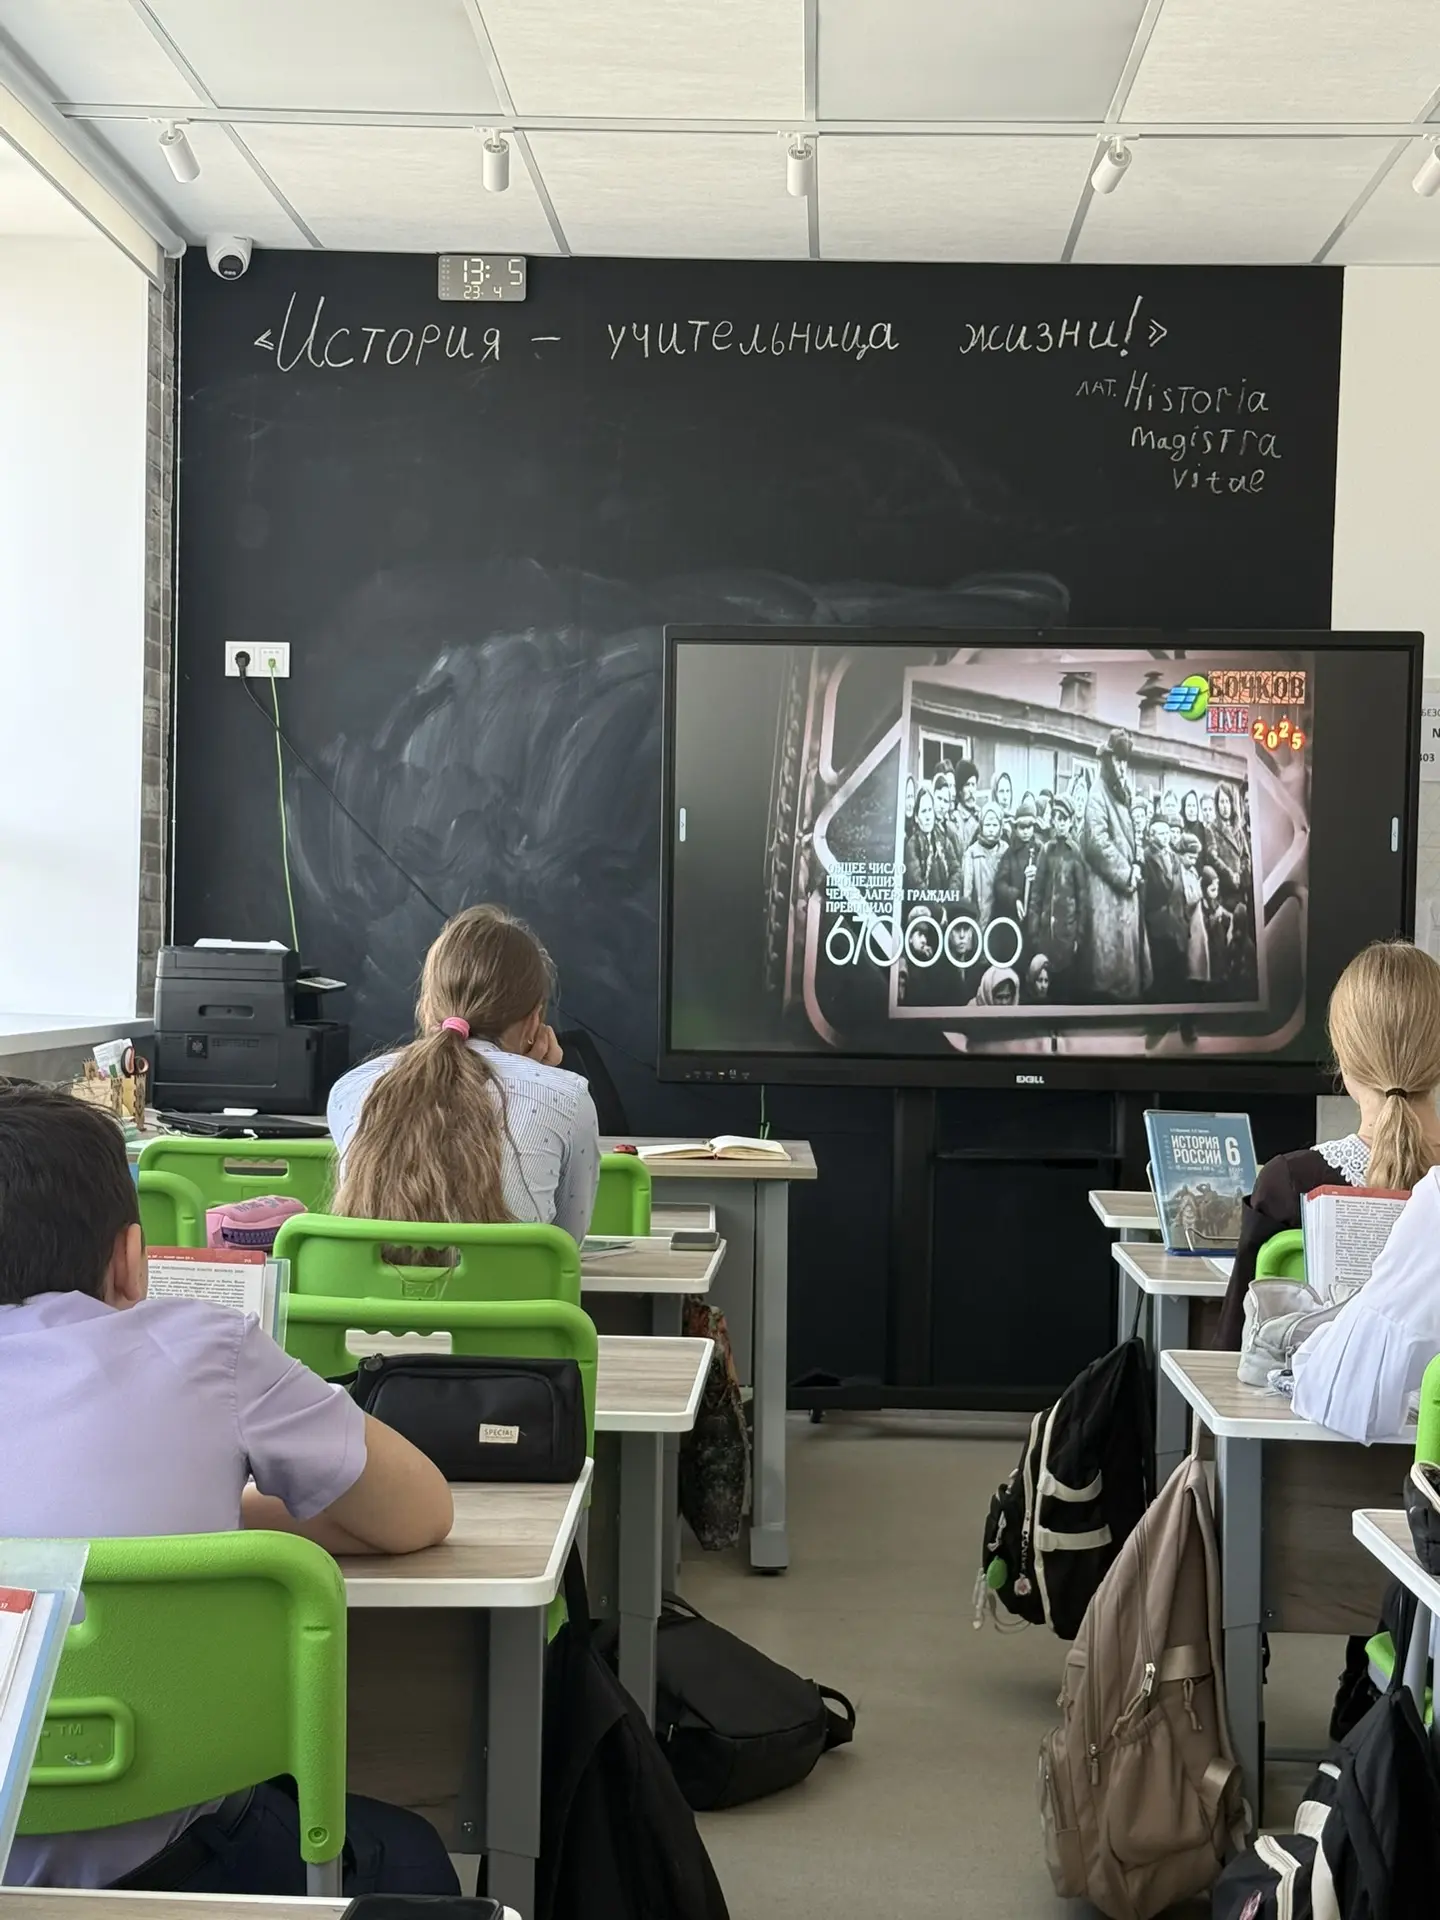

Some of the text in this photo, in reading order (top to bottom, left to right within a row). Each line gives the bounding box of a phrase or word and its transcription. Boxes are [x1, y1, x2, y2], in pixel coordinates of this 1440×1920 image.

[607, 320, 900, 360] учительница
[1208, 671, 1306, 704] БОЧКОВ
[1207, 706, 1248, 734] LIVE
[1253, 720, 1303, 750] 2025
[869, 862, 906, 875] ЧИСЛО
[907, 889, 960, 903] ГРАЖДАН
[1171, 1135, 1241, 1166] ИСТОРИЯ 6
[1173, 1148, 1222, 1165] РОССИИ
[484, 1428, 514, 1437] SPECIAL
